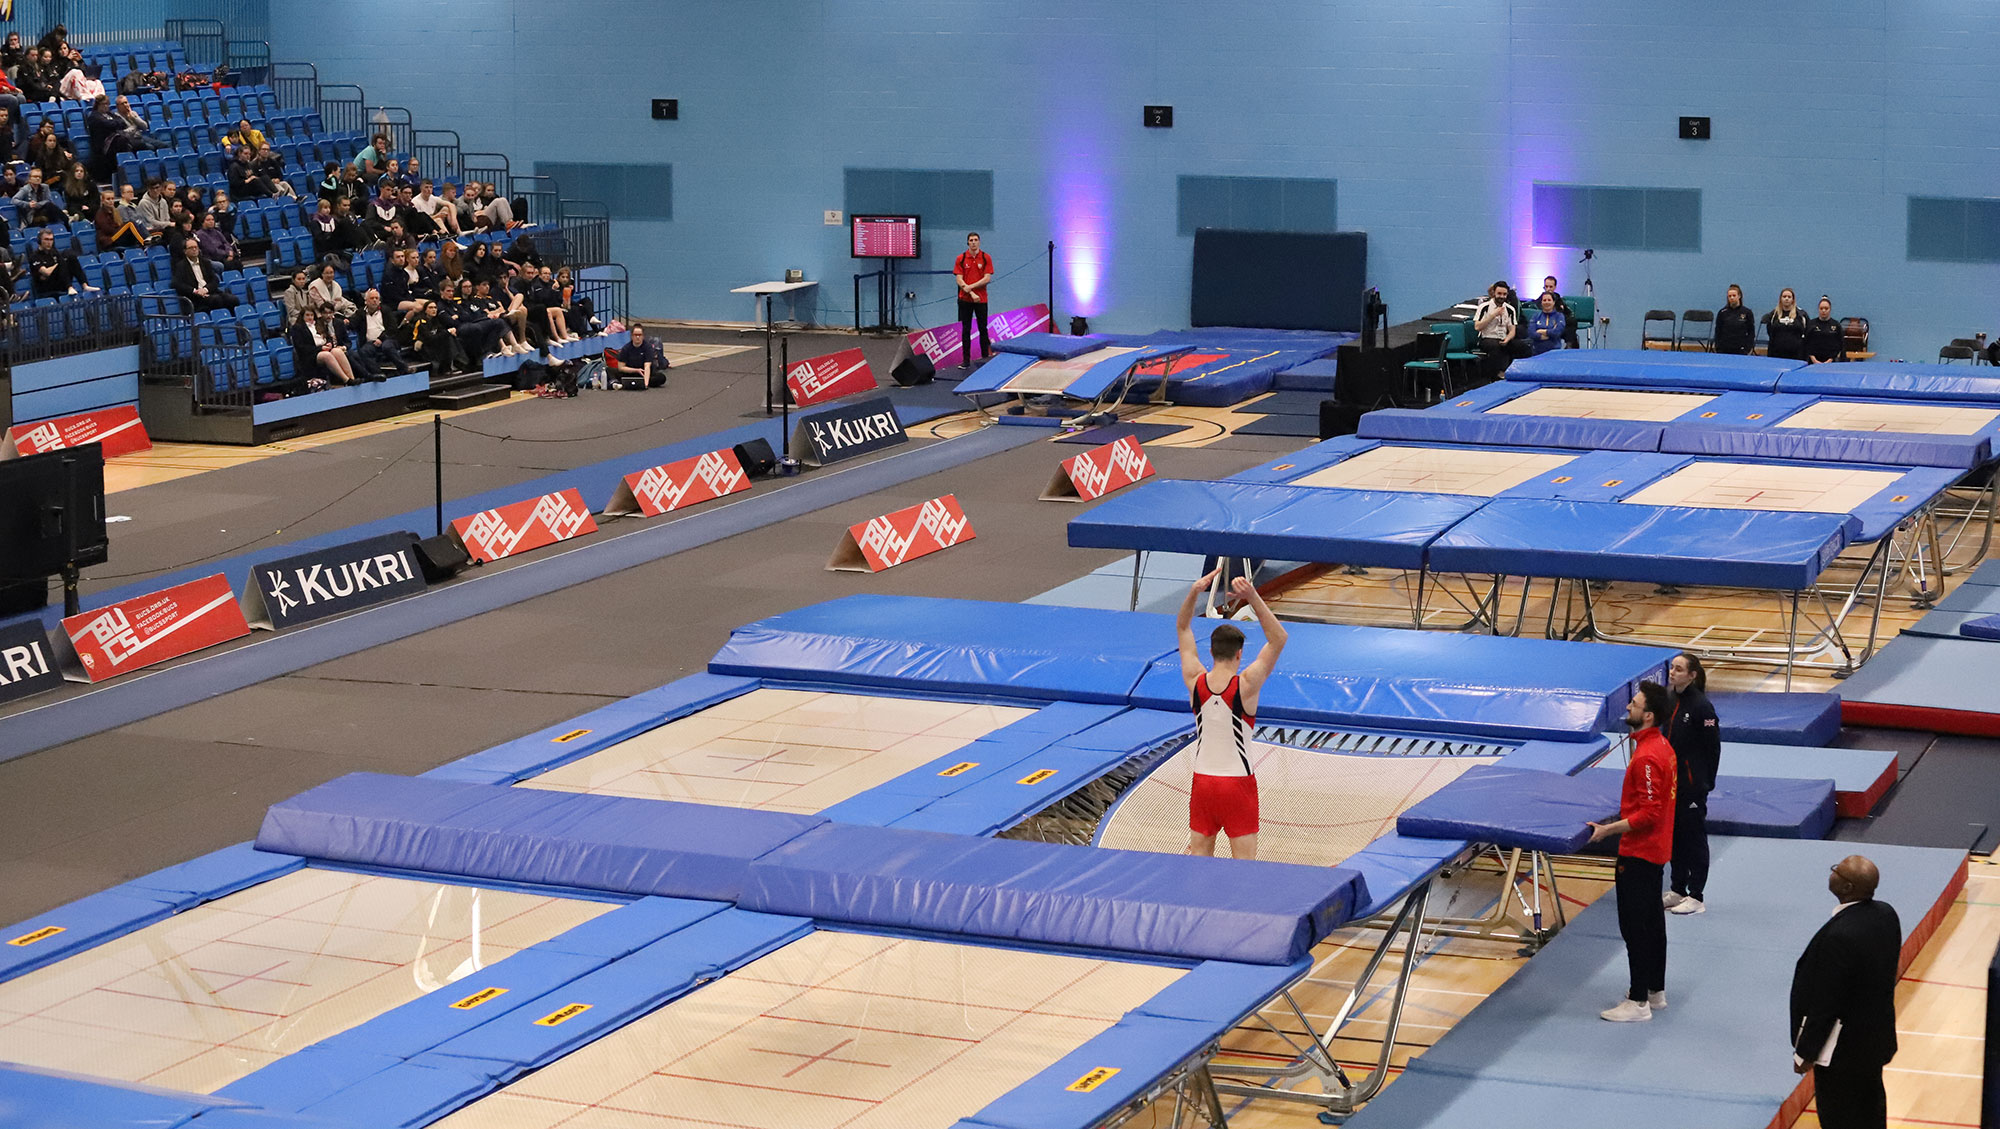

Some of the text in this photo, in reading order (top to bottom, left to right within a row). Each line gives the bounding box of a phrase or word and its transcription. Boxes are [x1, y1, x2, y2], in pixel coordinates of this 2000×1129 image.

[1155, 115, 1161, 124] 2
[1692, 127, 1698, 136] 3
[826, 411, 900, 450] KUKRI
[294, 550, 415, 606] KUKRI
[135, 596, 171, 620] BUCS.ORG.UK
[136, 601, 178, 630] FACEBOOK/BUCS
[144, 611, 179, 636] @BUCSSPORT
